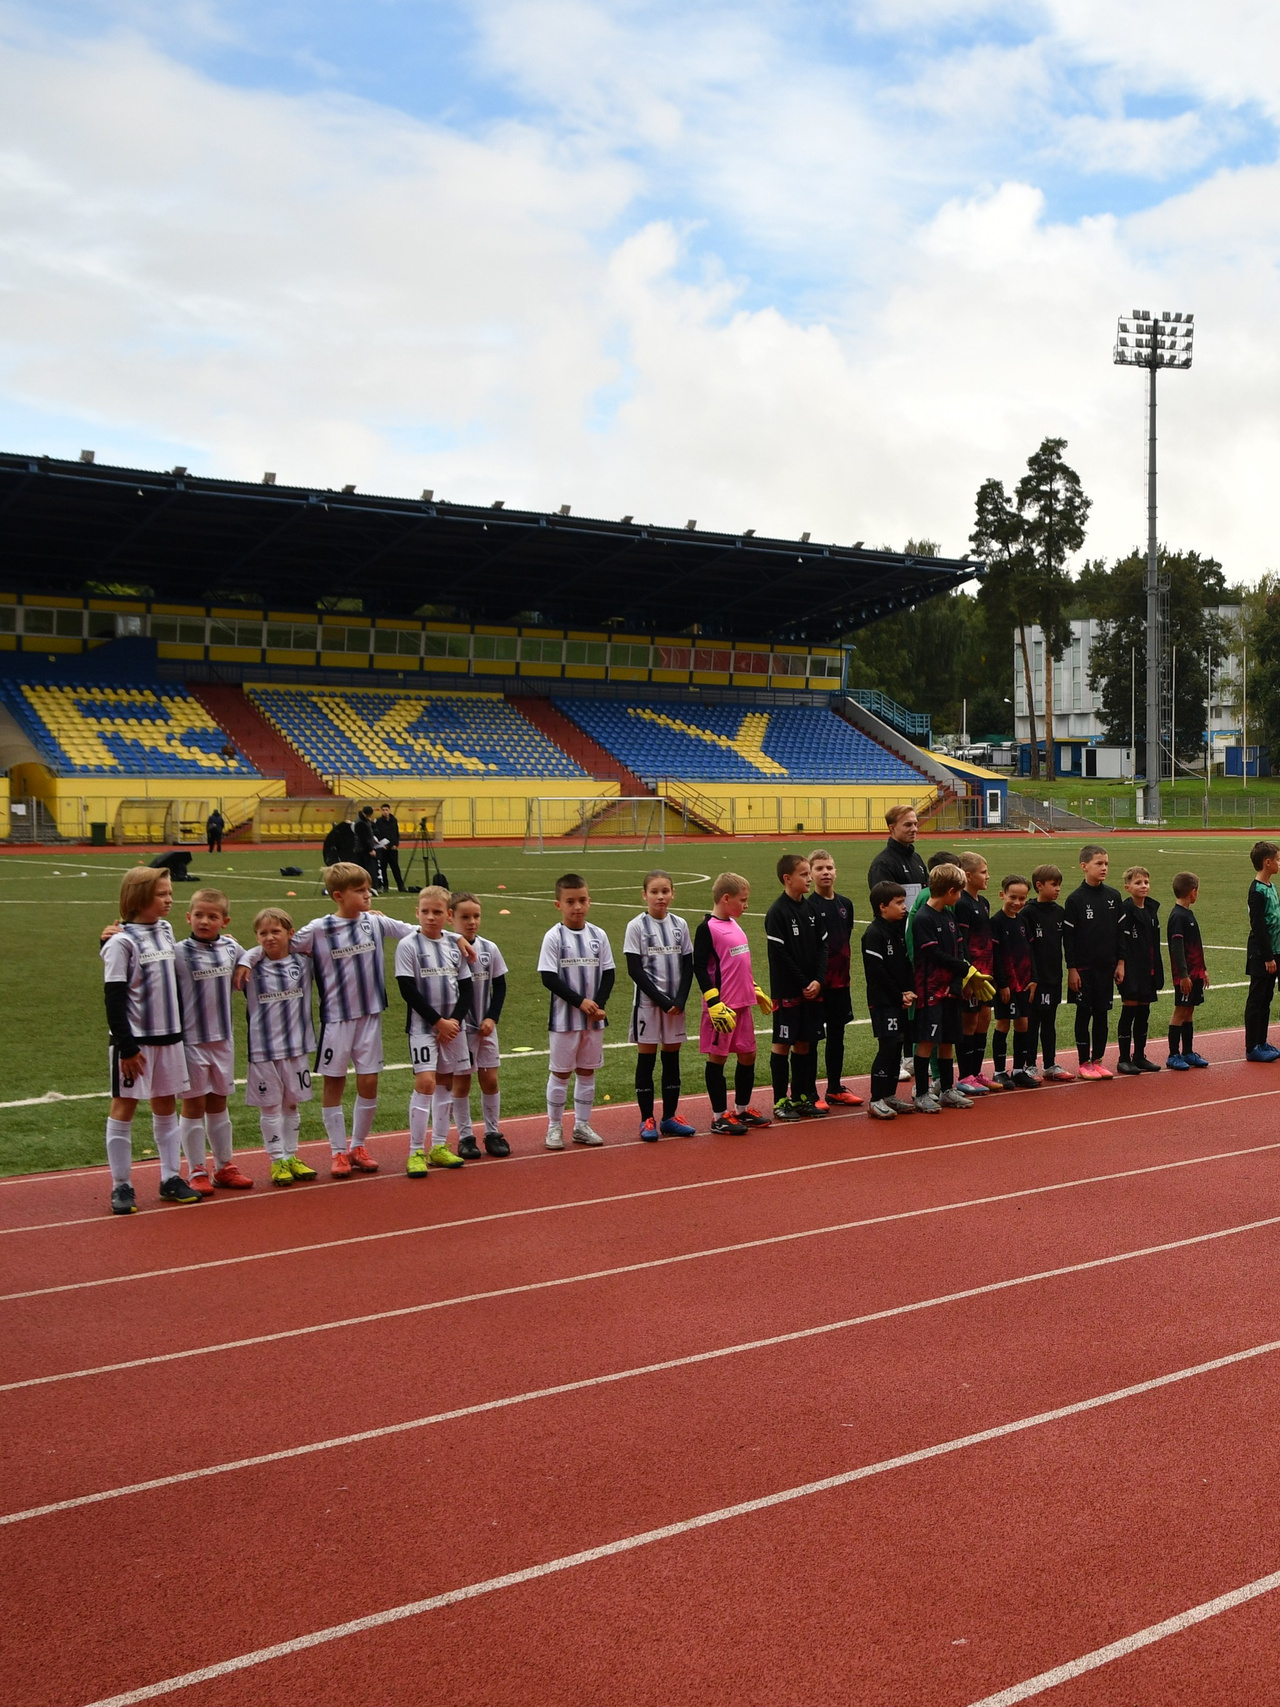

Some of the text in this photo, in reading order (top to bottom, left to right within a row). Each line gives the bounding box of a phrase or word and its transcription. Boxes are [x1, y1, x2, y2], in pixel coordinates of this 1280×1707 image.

[332, 946, 354, 956] FINISH
[355, 942, 375, 951] SPORT
[194, 968, 217, 977] FINISH
[260, 992, 283, 1000] FINISH
[284, 988, 303, 996] SPORT
[1040, 993, 1051, 1005] 14
[1009, 1003, 1017, 1015] 5
[640, 1020, 647, 1036] 7
[887, 1018, 898, 1031] 25
[930, 1024, 938, 1037] 7
[779, 1025, 790, 1039] 19
[323, 1047, 334, 1066] 9
[413, 1045, 431, 1065] 10
[296, 1068, 312, 1091] 10
